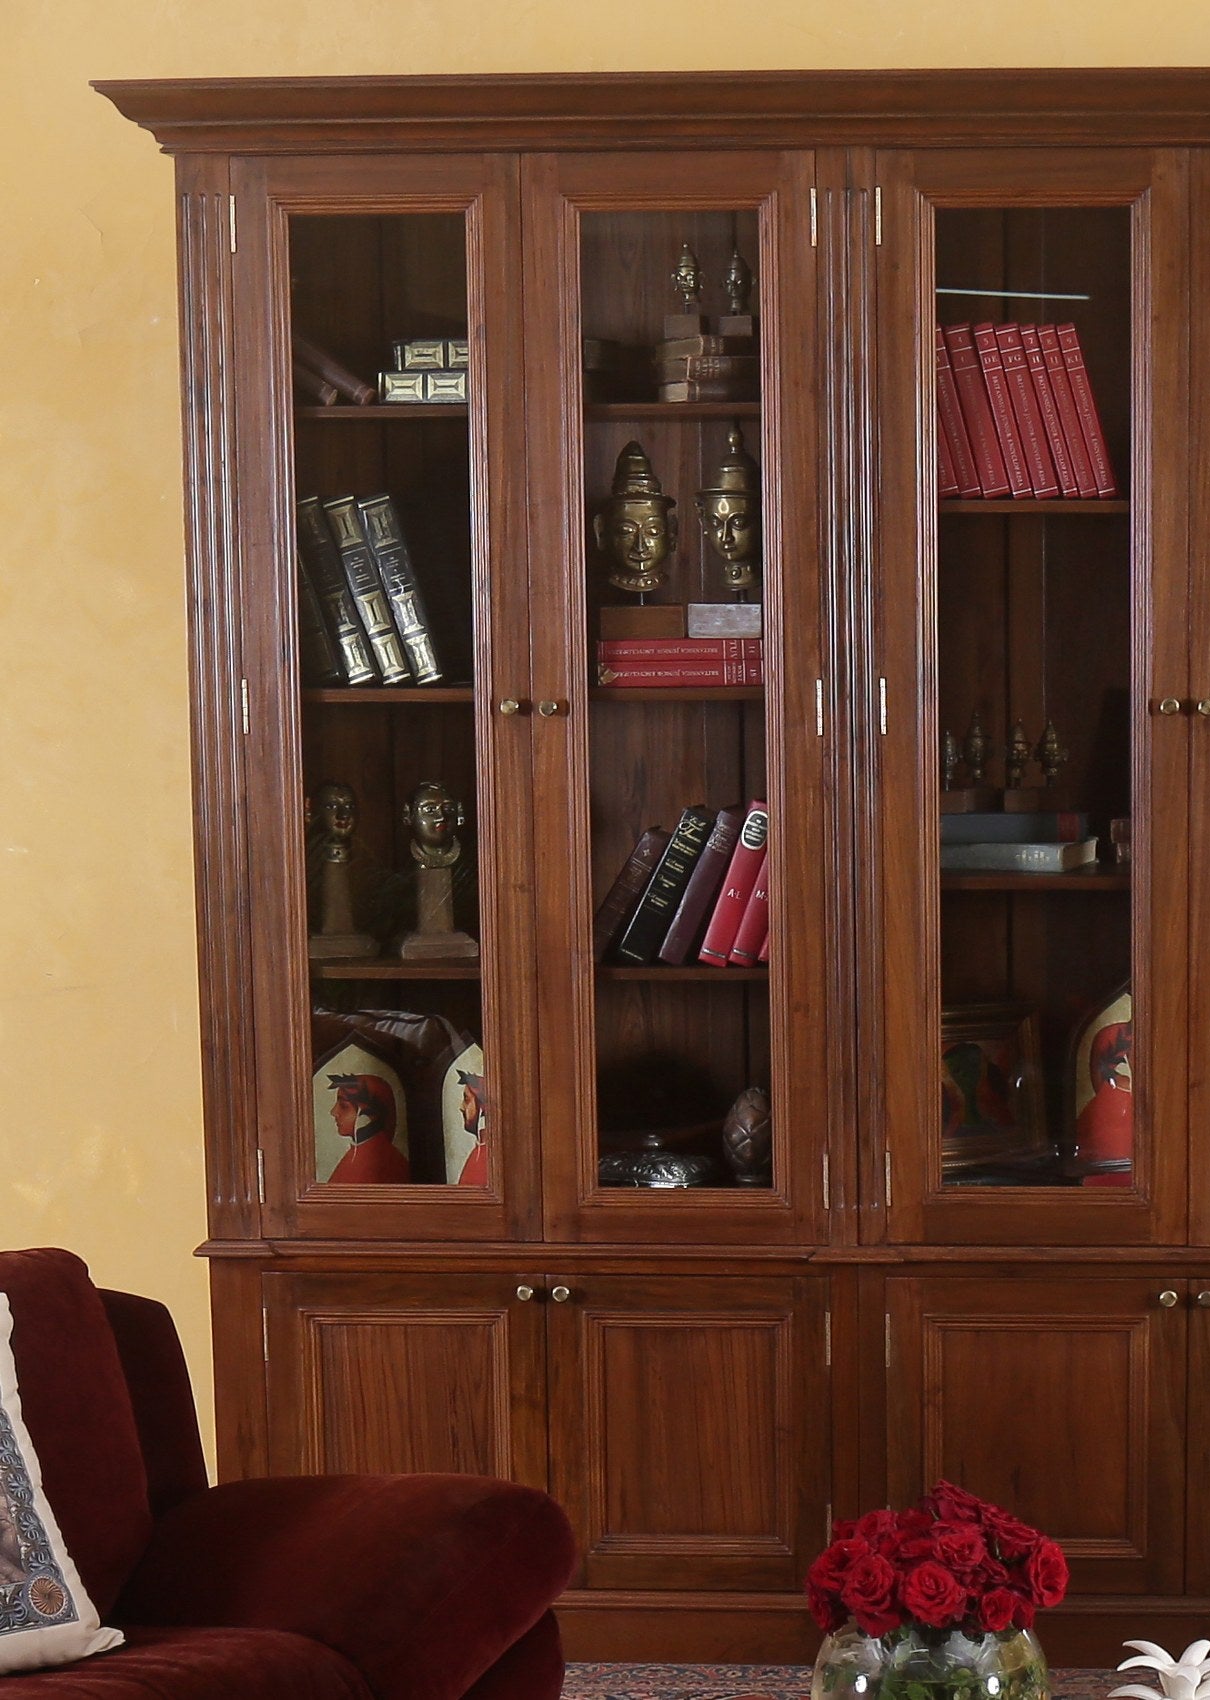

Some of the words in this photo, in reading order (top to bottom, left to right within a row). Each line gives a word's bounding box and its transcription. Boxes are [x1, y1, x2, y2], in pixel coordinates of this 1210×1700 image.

[983, 356, 998, 364] DE
[1007, 355, 1021, 363] FG
[729, 640, 738, 659] TUV
